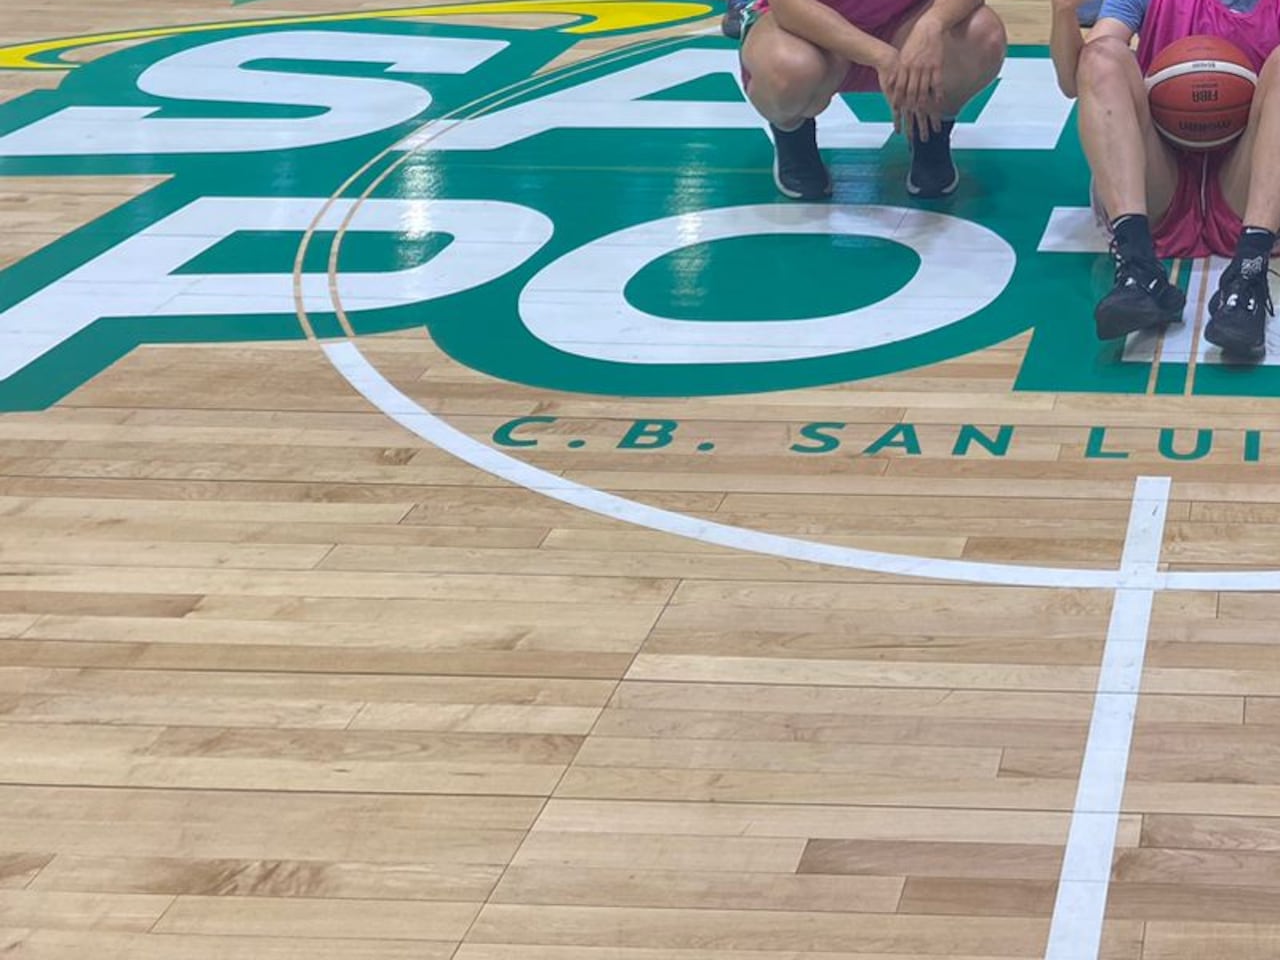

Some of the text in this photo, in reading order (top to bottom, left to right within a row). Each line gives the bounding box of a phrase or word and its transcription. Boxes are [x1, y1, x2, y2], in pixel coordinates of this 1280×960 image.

[1191, 89, 1219, 102] FIBA
[493, 415, 717, 452] C.B.
[790, 421, 1015, 458] SAN
